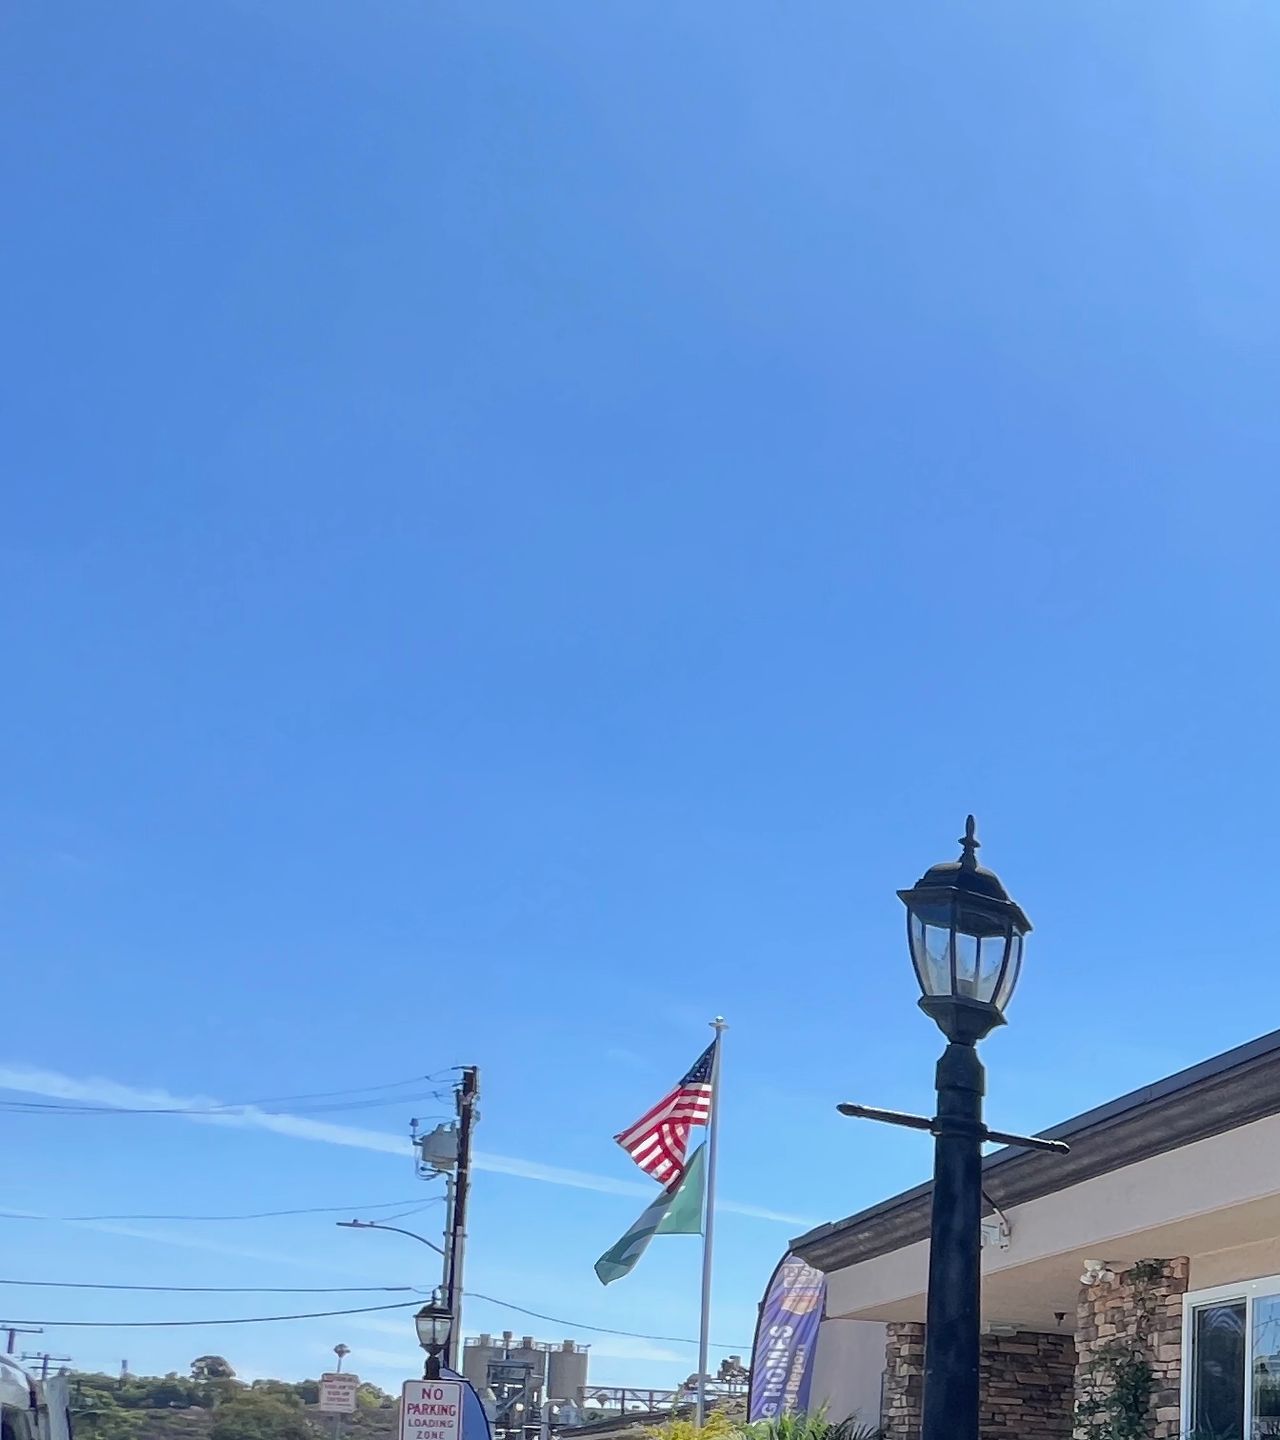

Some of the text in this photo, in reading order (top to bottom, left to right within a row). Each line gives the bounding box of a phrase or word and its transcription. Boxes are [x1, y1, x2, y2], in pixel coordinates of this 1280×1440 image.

[763, 1325, 793, 1396] HOMES
[421, 1387, 443, 1400] NO
[407, 1403, 456, 1416] PARKING
[408, 1419, 454, 1428] LOADING
[416, 1431, 445, 1439] ZONE
